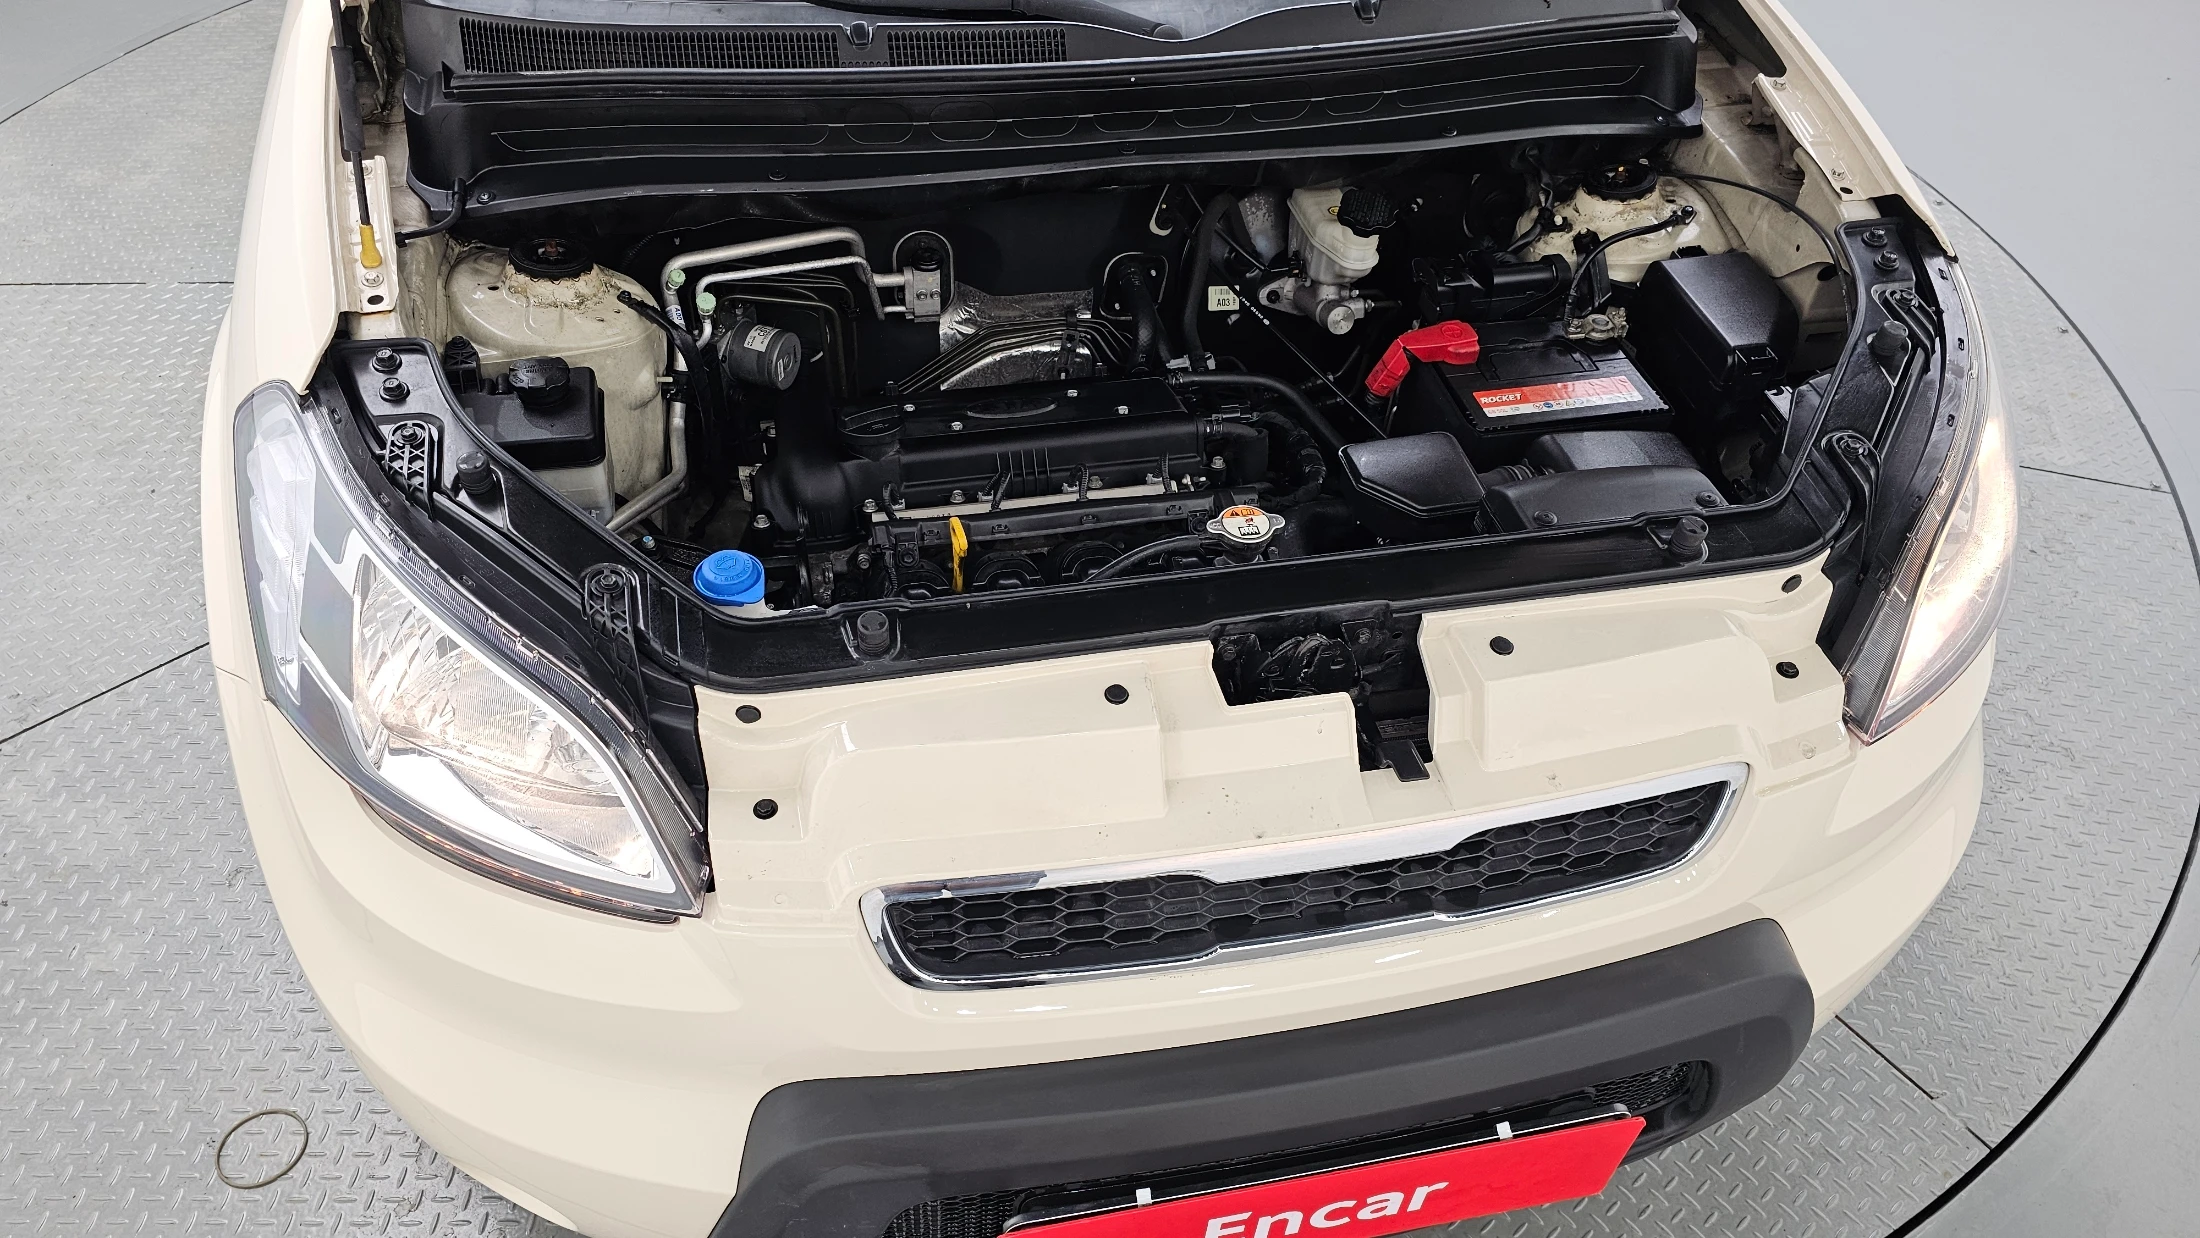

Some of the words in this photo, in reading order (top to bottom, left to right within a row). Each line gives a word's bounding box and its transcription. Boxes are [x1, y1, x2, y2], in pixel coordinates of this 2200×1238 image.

[1216, 298, 1231, 307] A03
[1480, 393, 1522, 404] ROCKET
[1203, 1181, 1450, 1238] Encar
